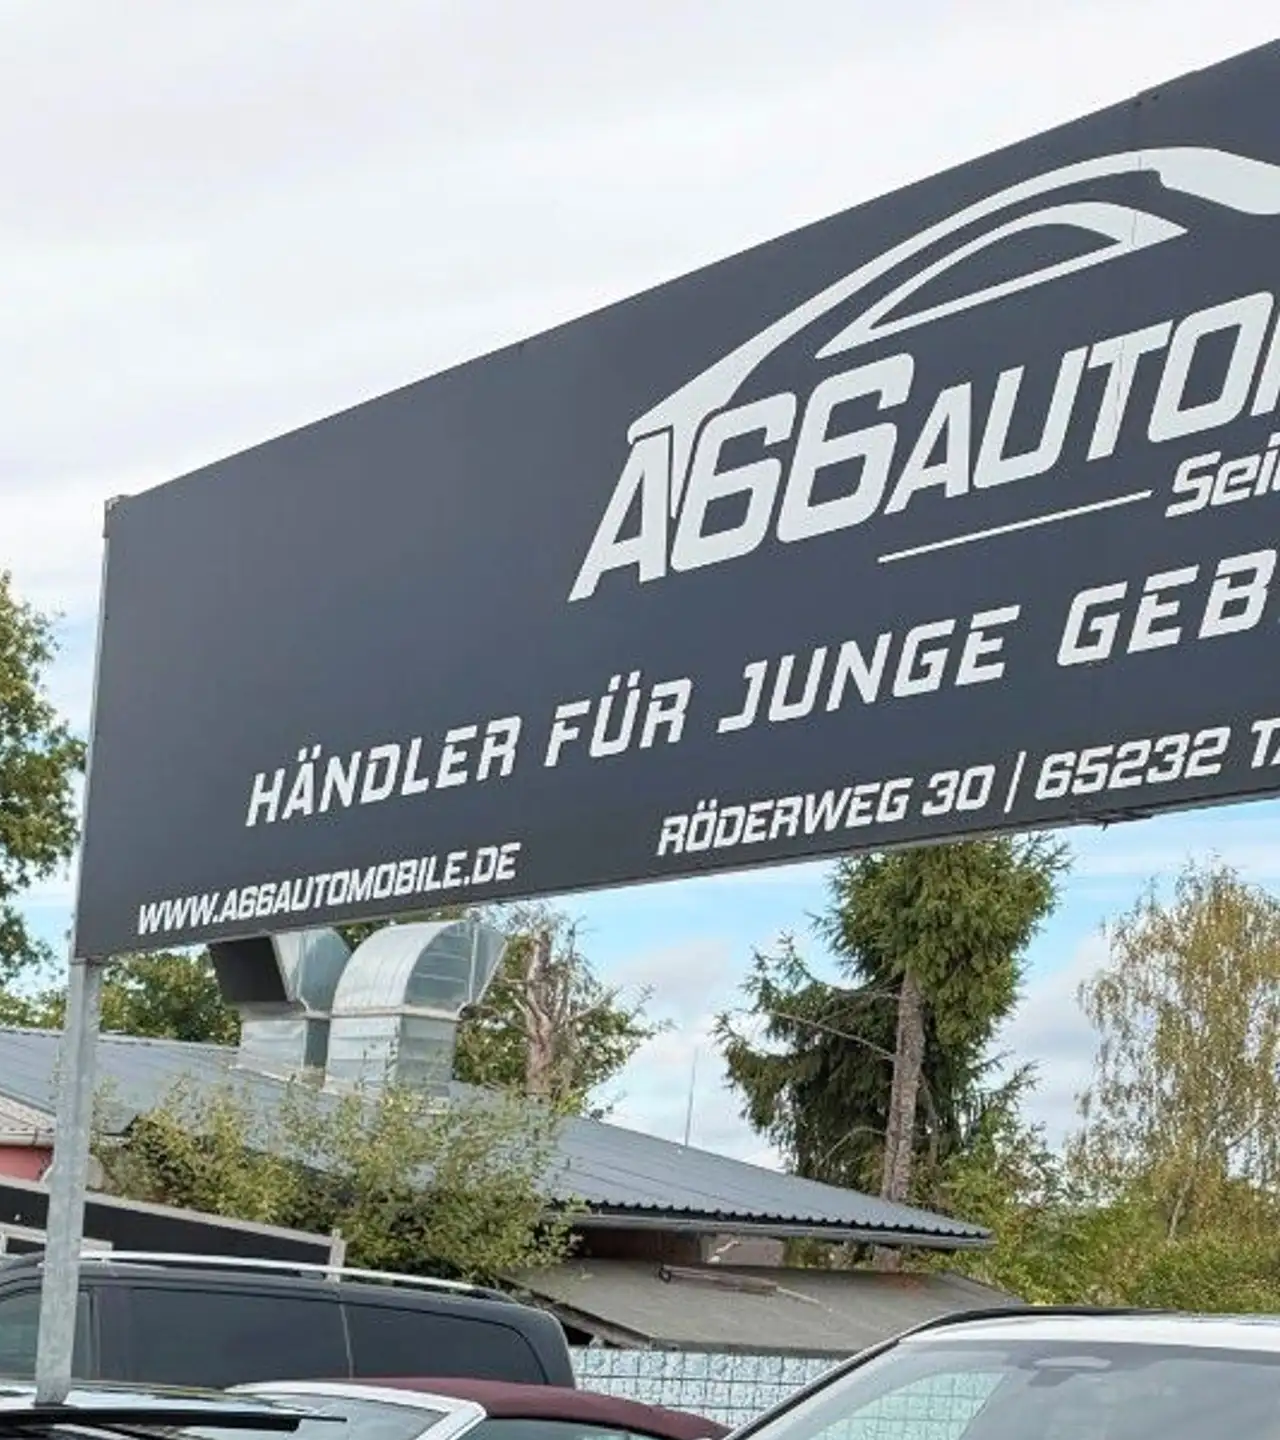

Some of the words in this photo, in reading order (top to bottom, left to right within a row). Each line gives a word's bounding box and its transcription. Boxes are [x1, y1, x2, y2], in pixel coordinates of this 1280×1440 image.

[567, 291, 1280, 603] A66AUTO
[1164, 432, 1280, 518] Sei
[245, 715, 522, 827] HÄNDLER
[543, 670, 693, 767] FÜR
[717, 604, 1021, 734] JUNGE
[1056, 548, 1280, 667] GEB
[656, 777, 914, 856] RÖDERWEG
[921, 764, 996, 817] 30
[1034, 726, 1231, 801] 65232
[1251, 717, 1280, 769] T
[137, 841, 522, 935] WWW.A66AUTOMOBILE.DE
